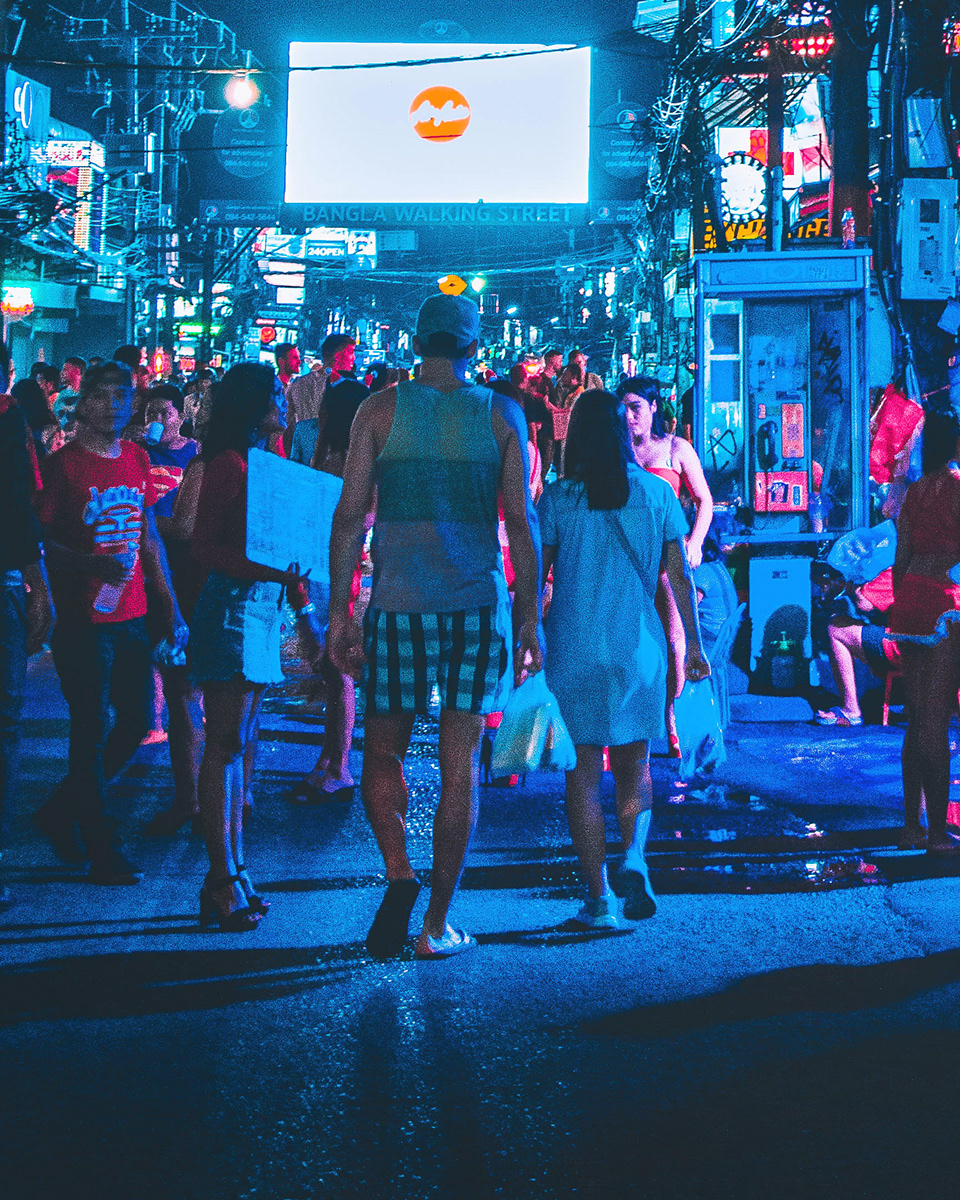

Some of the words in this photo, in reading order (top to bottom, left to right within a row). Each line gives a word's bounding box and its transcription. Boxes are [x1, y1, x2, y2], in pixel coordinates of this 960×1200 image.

[302, 205, 387, 222] BANGLA
[395, 205, 490, 222] WALKING
[498, 205, 574, 222] STREET
